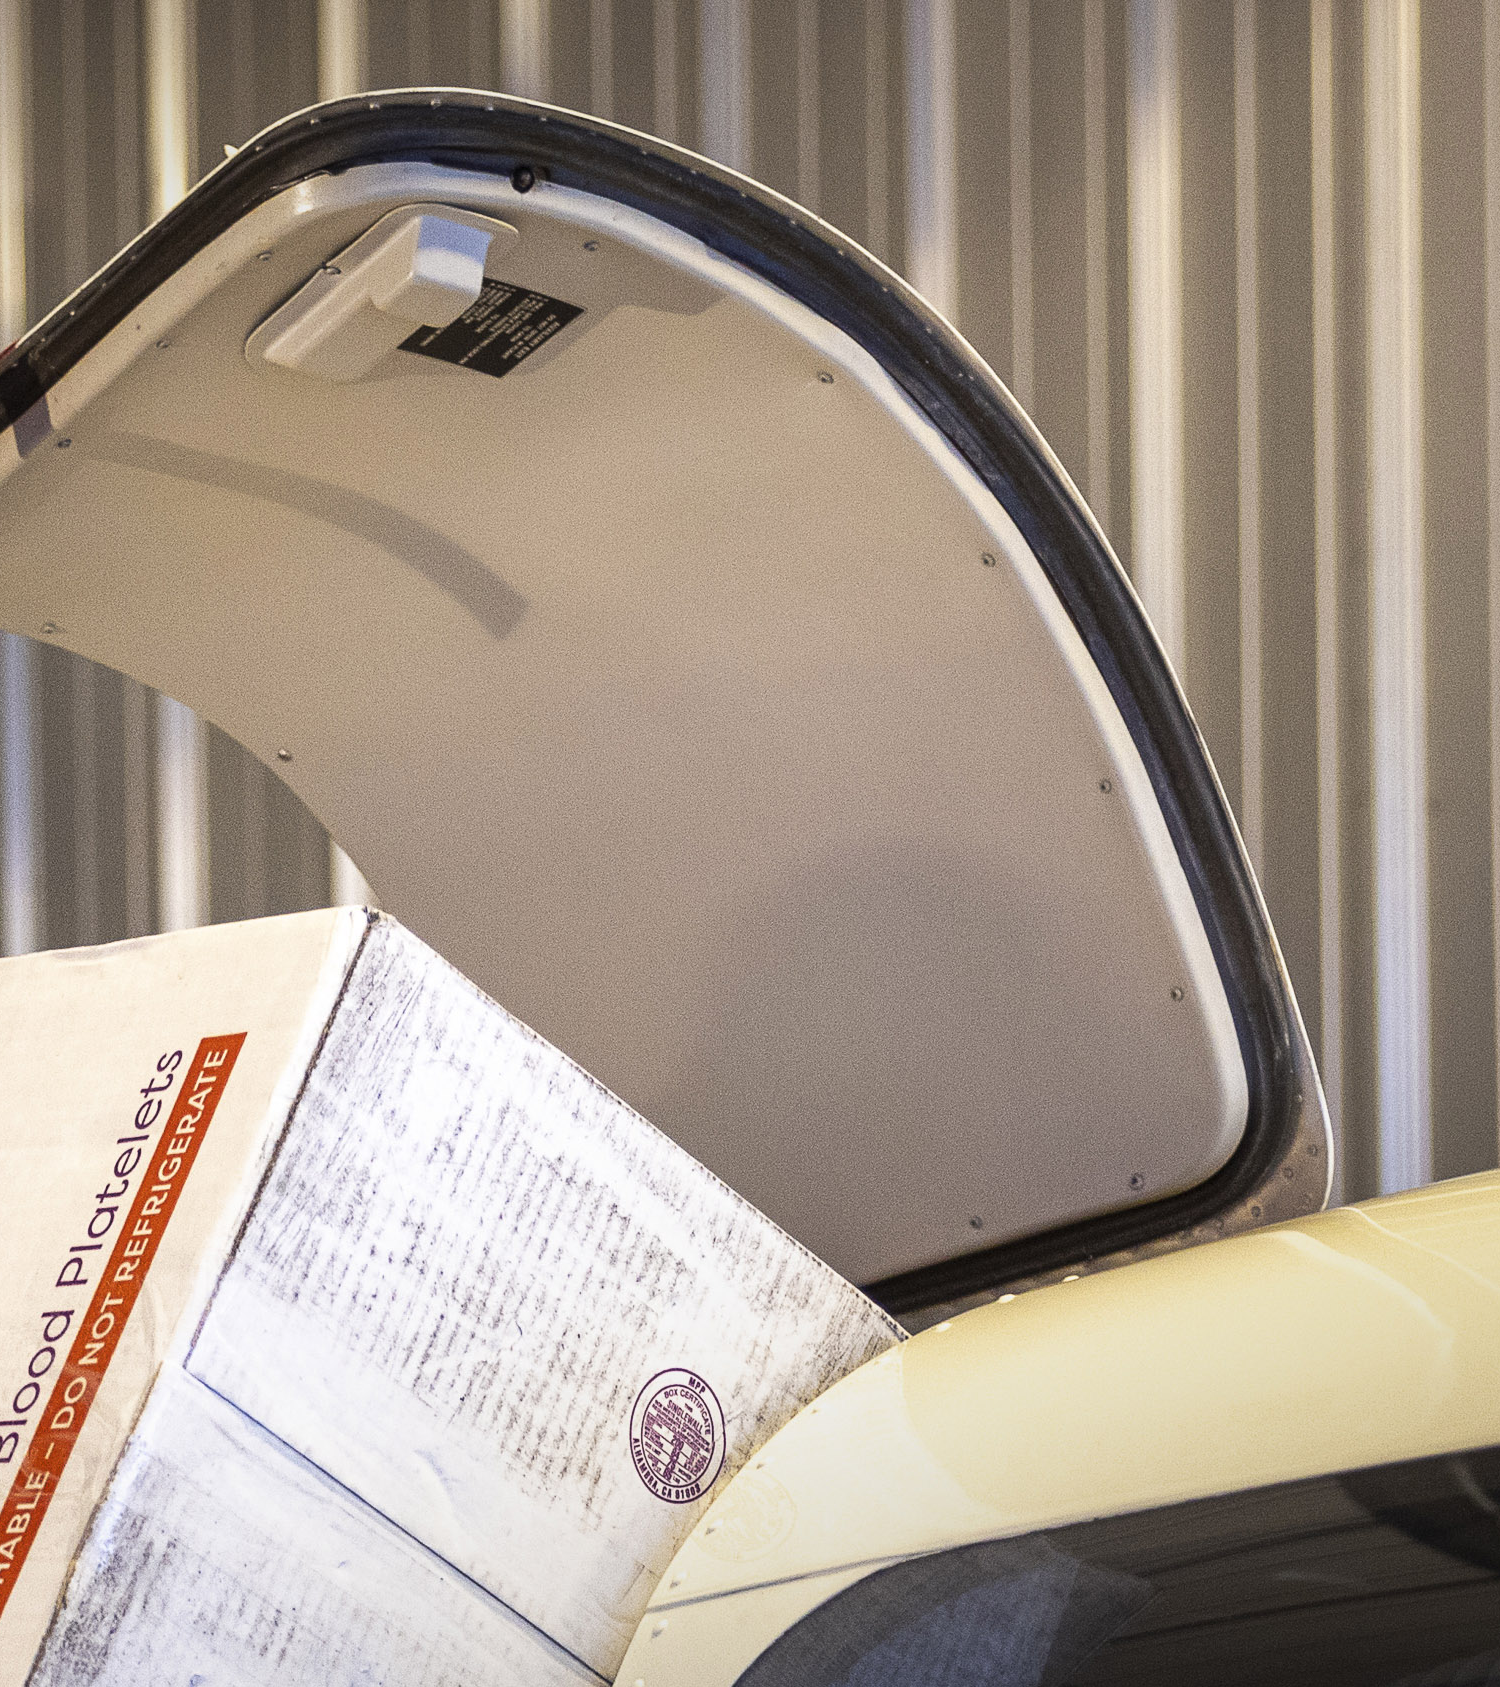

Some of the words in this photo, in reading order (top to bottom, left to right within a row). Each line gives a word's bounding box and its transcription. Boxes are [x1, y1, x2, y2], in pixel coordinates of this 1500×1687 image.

[56, 1049, 183, 1288] Platelets
[51, 1376, 88, 1429] DO
[79, 1293, 124, 1366] NOT
[114, 1048, 228, 1282] REFRIGERATE
[664, 1388, 678, 1399] BOX
[679, 1389, 711, 1436] CERTIFICATE
[688, 1376, 706, 1394] MPP
[667, 1400, 703, 1435] SINGLEWALL
[632, 1437, 659, 1494] ALHAMBRA,
[661, 1486, 672, 1499] CA
